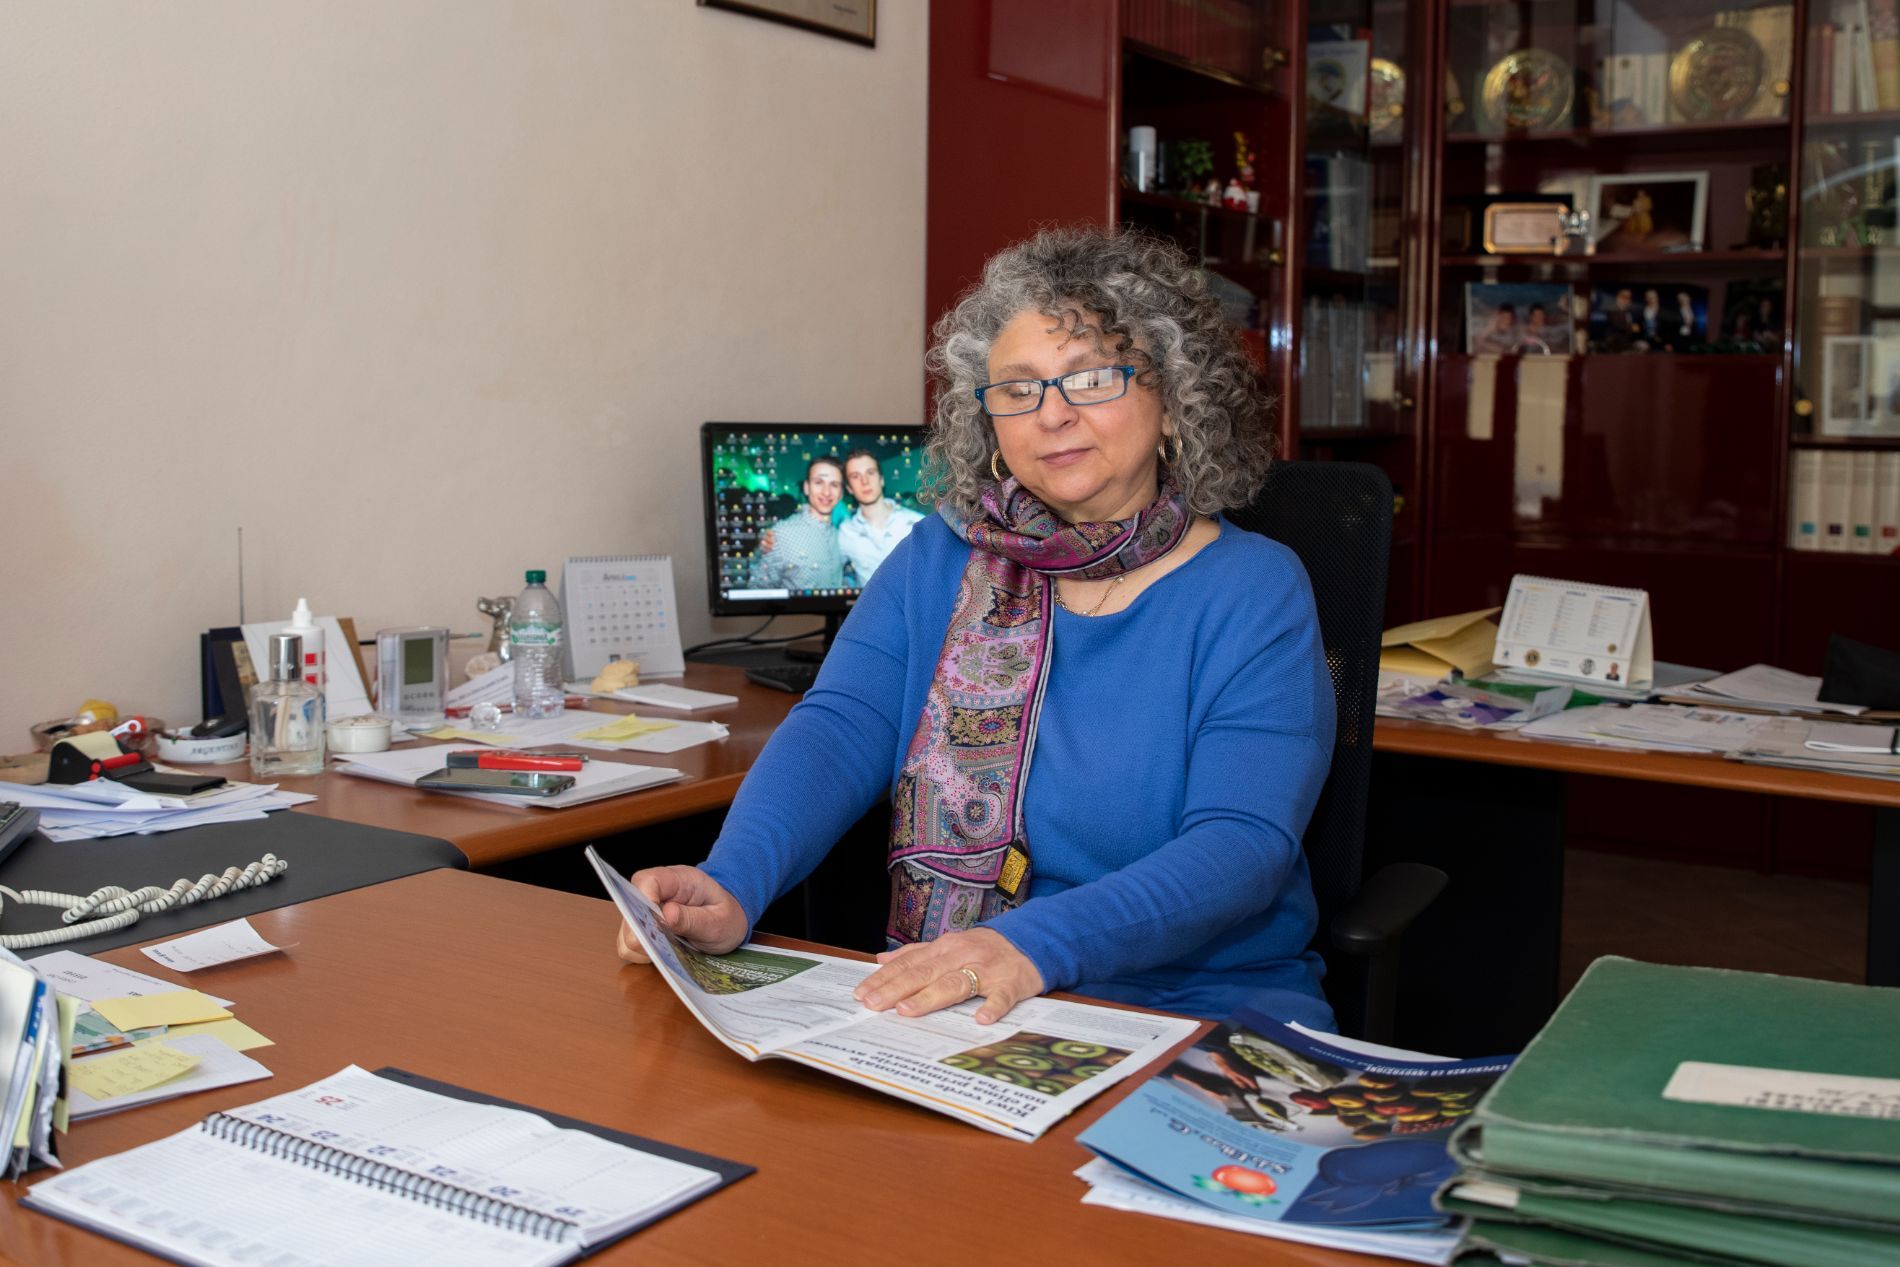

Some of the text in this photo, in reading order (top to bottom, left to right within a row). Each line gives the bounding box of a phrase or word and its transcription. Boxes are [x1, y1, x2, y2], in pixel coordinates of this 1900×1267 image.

[869, 1054, 971, 1088] primaverile
[849, 1056, 1029, 1117] Kiwi verde nazionale
[975, 1086, 1020, 1104] clima
[314, 1095, 345, 1106] 25
[1013, 1091, 1048, 1105] non
